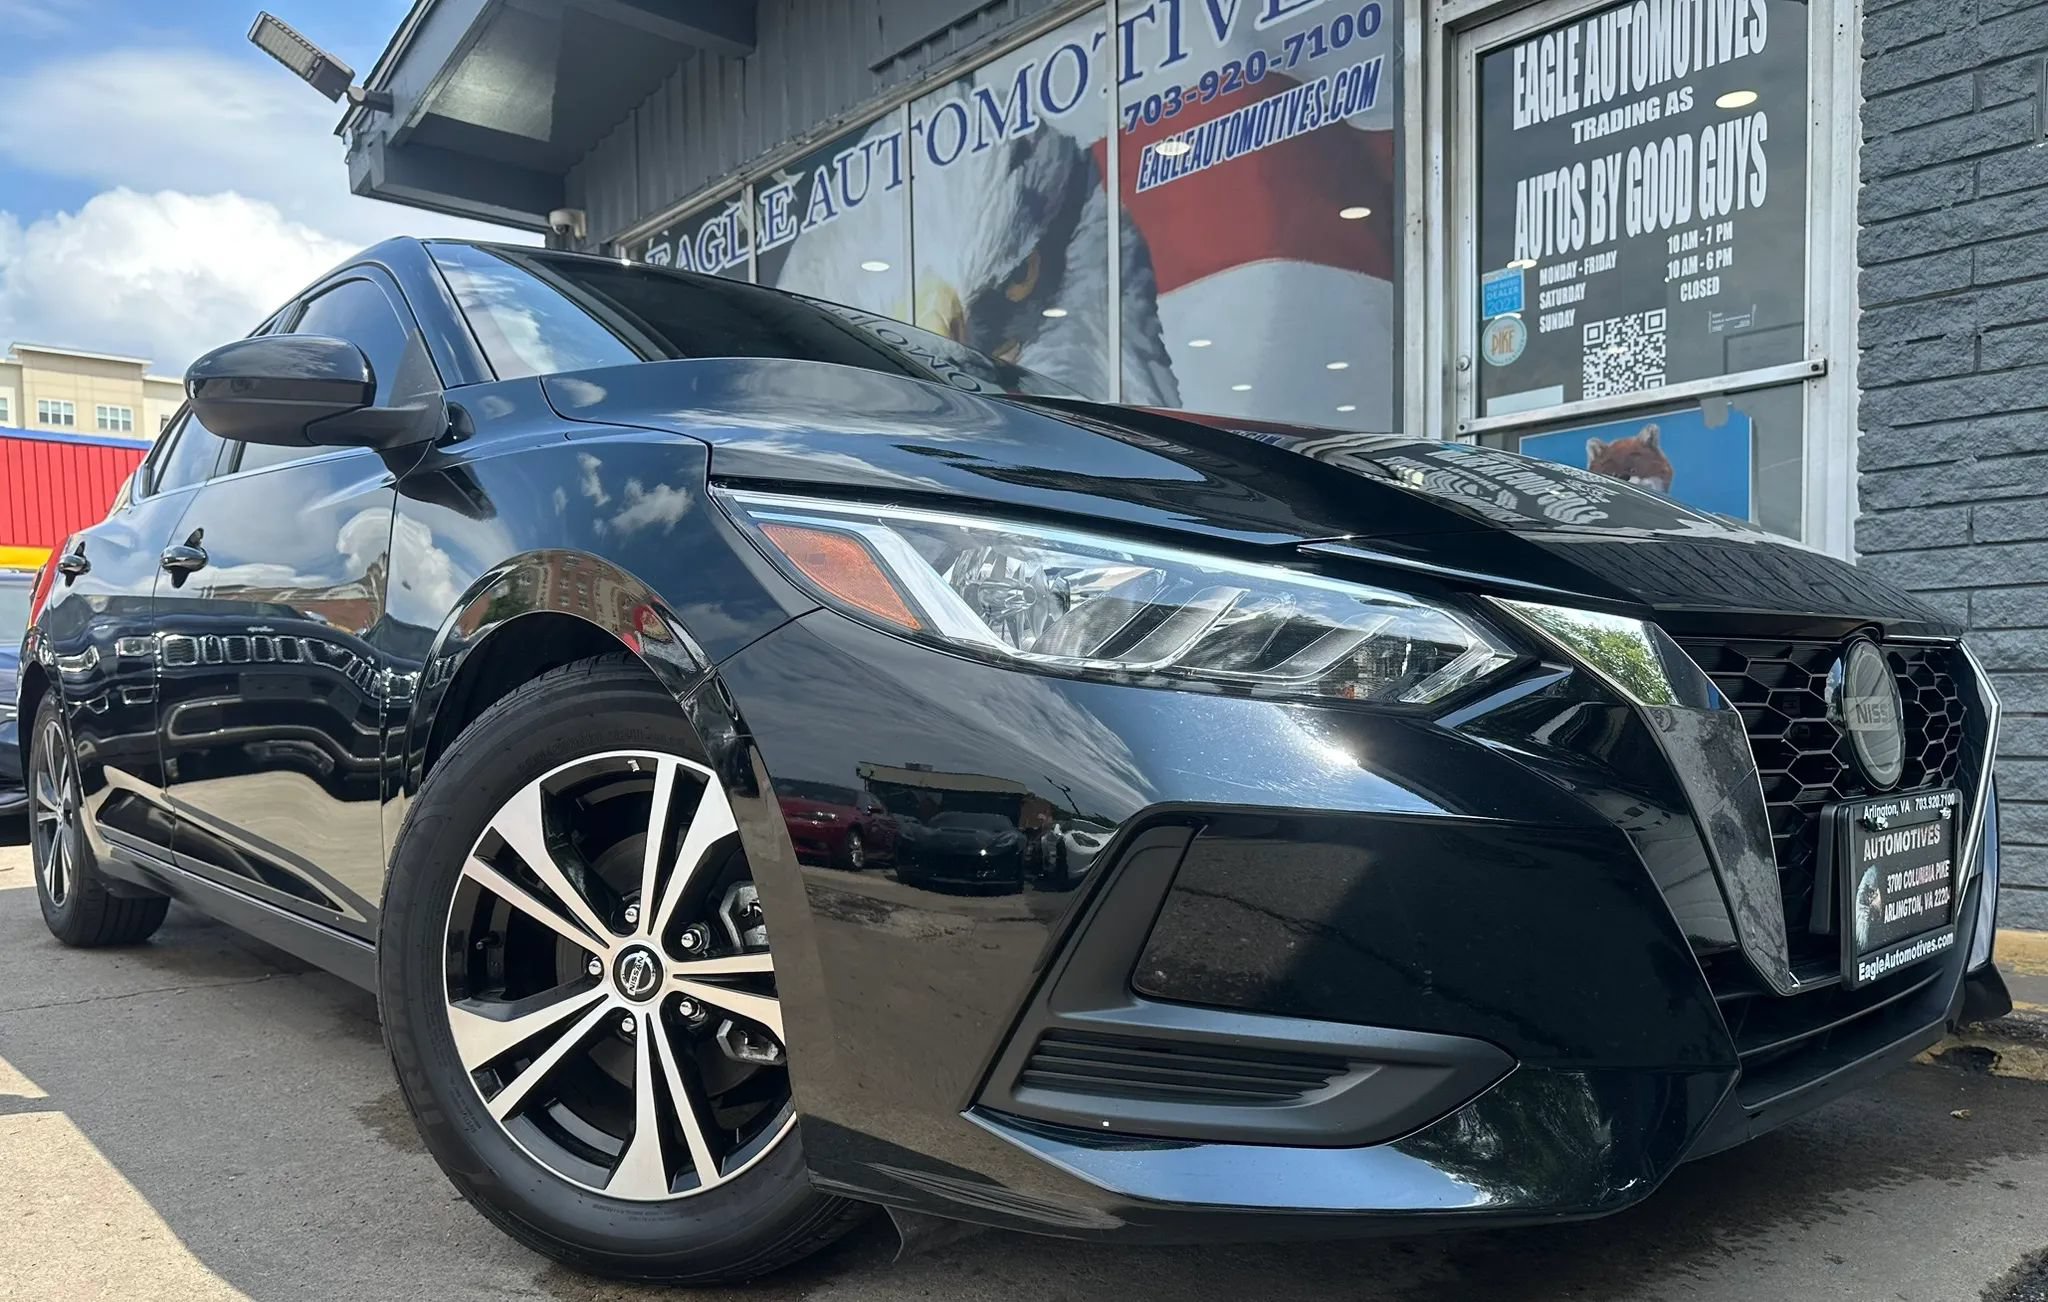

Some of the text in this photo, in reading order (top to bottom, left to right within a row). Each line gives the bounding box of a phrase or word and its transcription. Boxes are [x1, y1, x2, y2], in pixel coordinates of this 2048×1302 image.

[1124, 2, 1382, 134] 703-920-7100
[1513, 0, 1767, 130] EAGLE AUTOMOTIVES
[801, 0, 1326, 232] AUTOMOTIV
[1136, 54, 1385, 193] EAGLEAUTOMOTIVES.COM
[1572, 86, 1694, 144] TRADING AS
[1514, 111, 1768, 261] AUTOS BY GOOD GUYS
[1667, 236, 1680, 254] 10
[1681, 230, 1698, 250] AM
[1706, 226, 1712, 245] 7
[1716, 221, 1733, 242] PM
[1539, 260, 1577, 286] MONDAY
[1584, 250, 1617, 275] FRIDAY
[1667, 261, 1680, 280] 10
[1681, 255, 1698, 276] AM
[1706, 252, 1714, 271] 6
[1716, 247, 1732, 269] PM
[1539, 282, 1586, 310] SATURDAY
[1680, 276, 1719, 302] CLOSED
[1539, 308, 1576, 333] SUNDAY
[1863, 793, 1955, 820] Arlington, VA 703.920.7100
[1863, 824, 1940, 861] AUTOMOTIVES
[1887, 860, 1950, 894] 3700 COLUMBIA PIKE
[1883, 895, 1922, 924] ARLINGTON,
[1924, 891, 1933, 910] VA
[628, 955, 645, 992] NISSAN
[1858, 932, 1954, 981] EagleAutomotives.com
